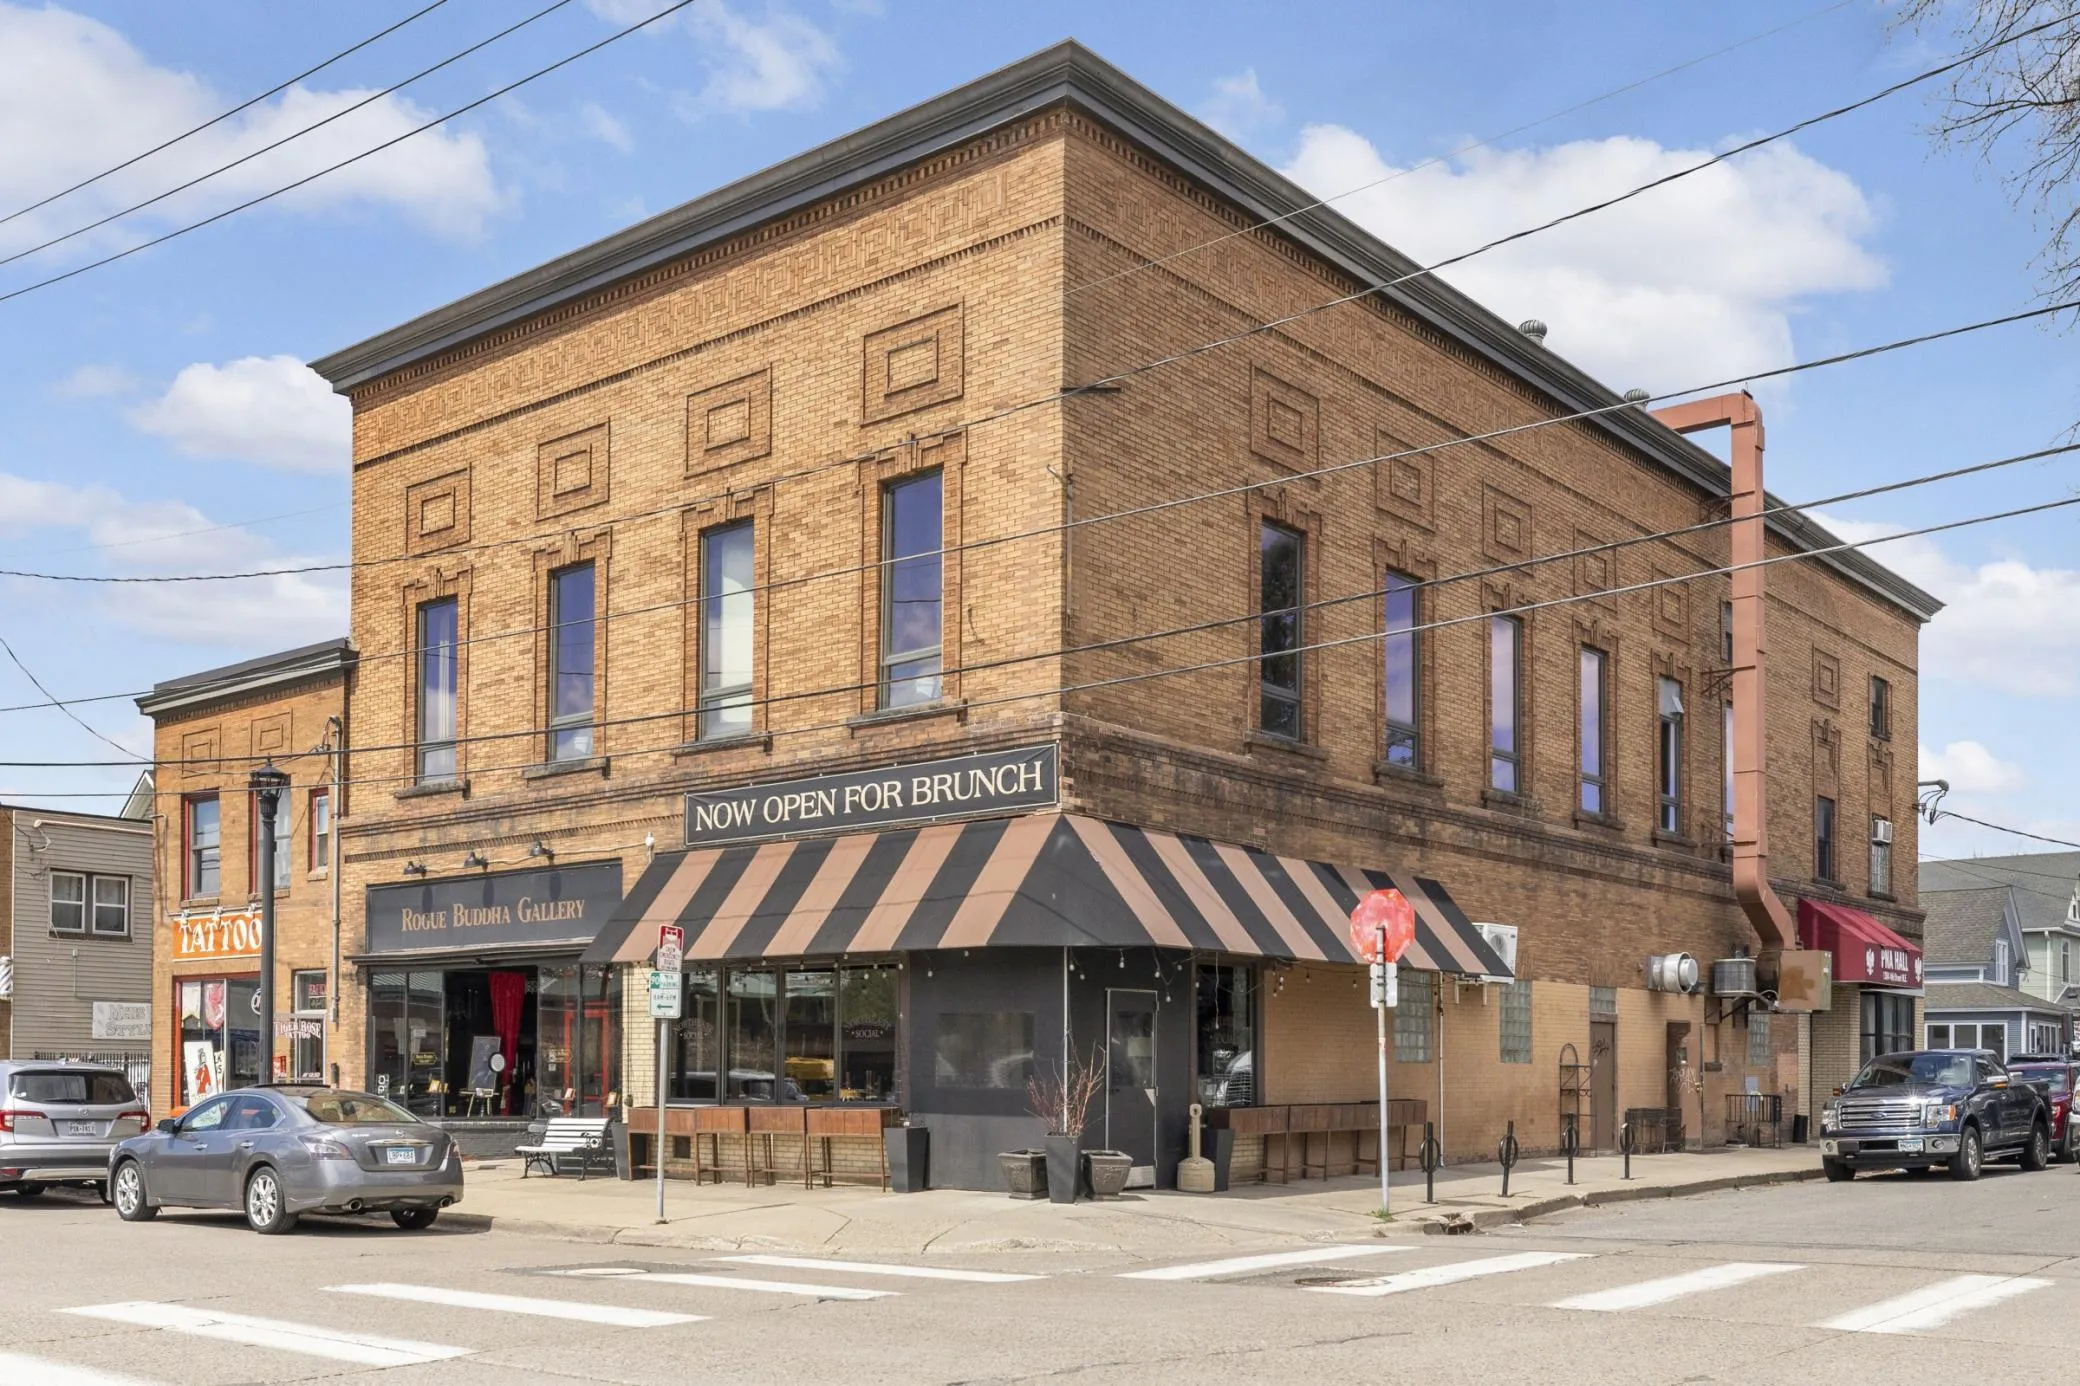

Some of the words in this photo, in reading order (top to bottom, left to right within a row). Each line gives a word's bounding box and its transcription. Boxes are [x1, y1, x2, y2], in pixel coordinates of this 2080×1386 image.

[696, 799, 757, 831] NOW
[763, 788, 837, 823] OPEN
[843, 780, 904, 814] FOR
[911, 760, 1043, 806] BRUNCH
[401, 907, 447, 932] ROGUE
[453, 903, 511, 928] BUDDHA
[517, 896, 585, 924] GALLERY
[178, 917, 262, 954] TATTOO
[1894, 950, 1909, 972] HALL
[300, 1020, 322, 1039] ROSE
[855, 1029, 880, 1039] SOCIAL
